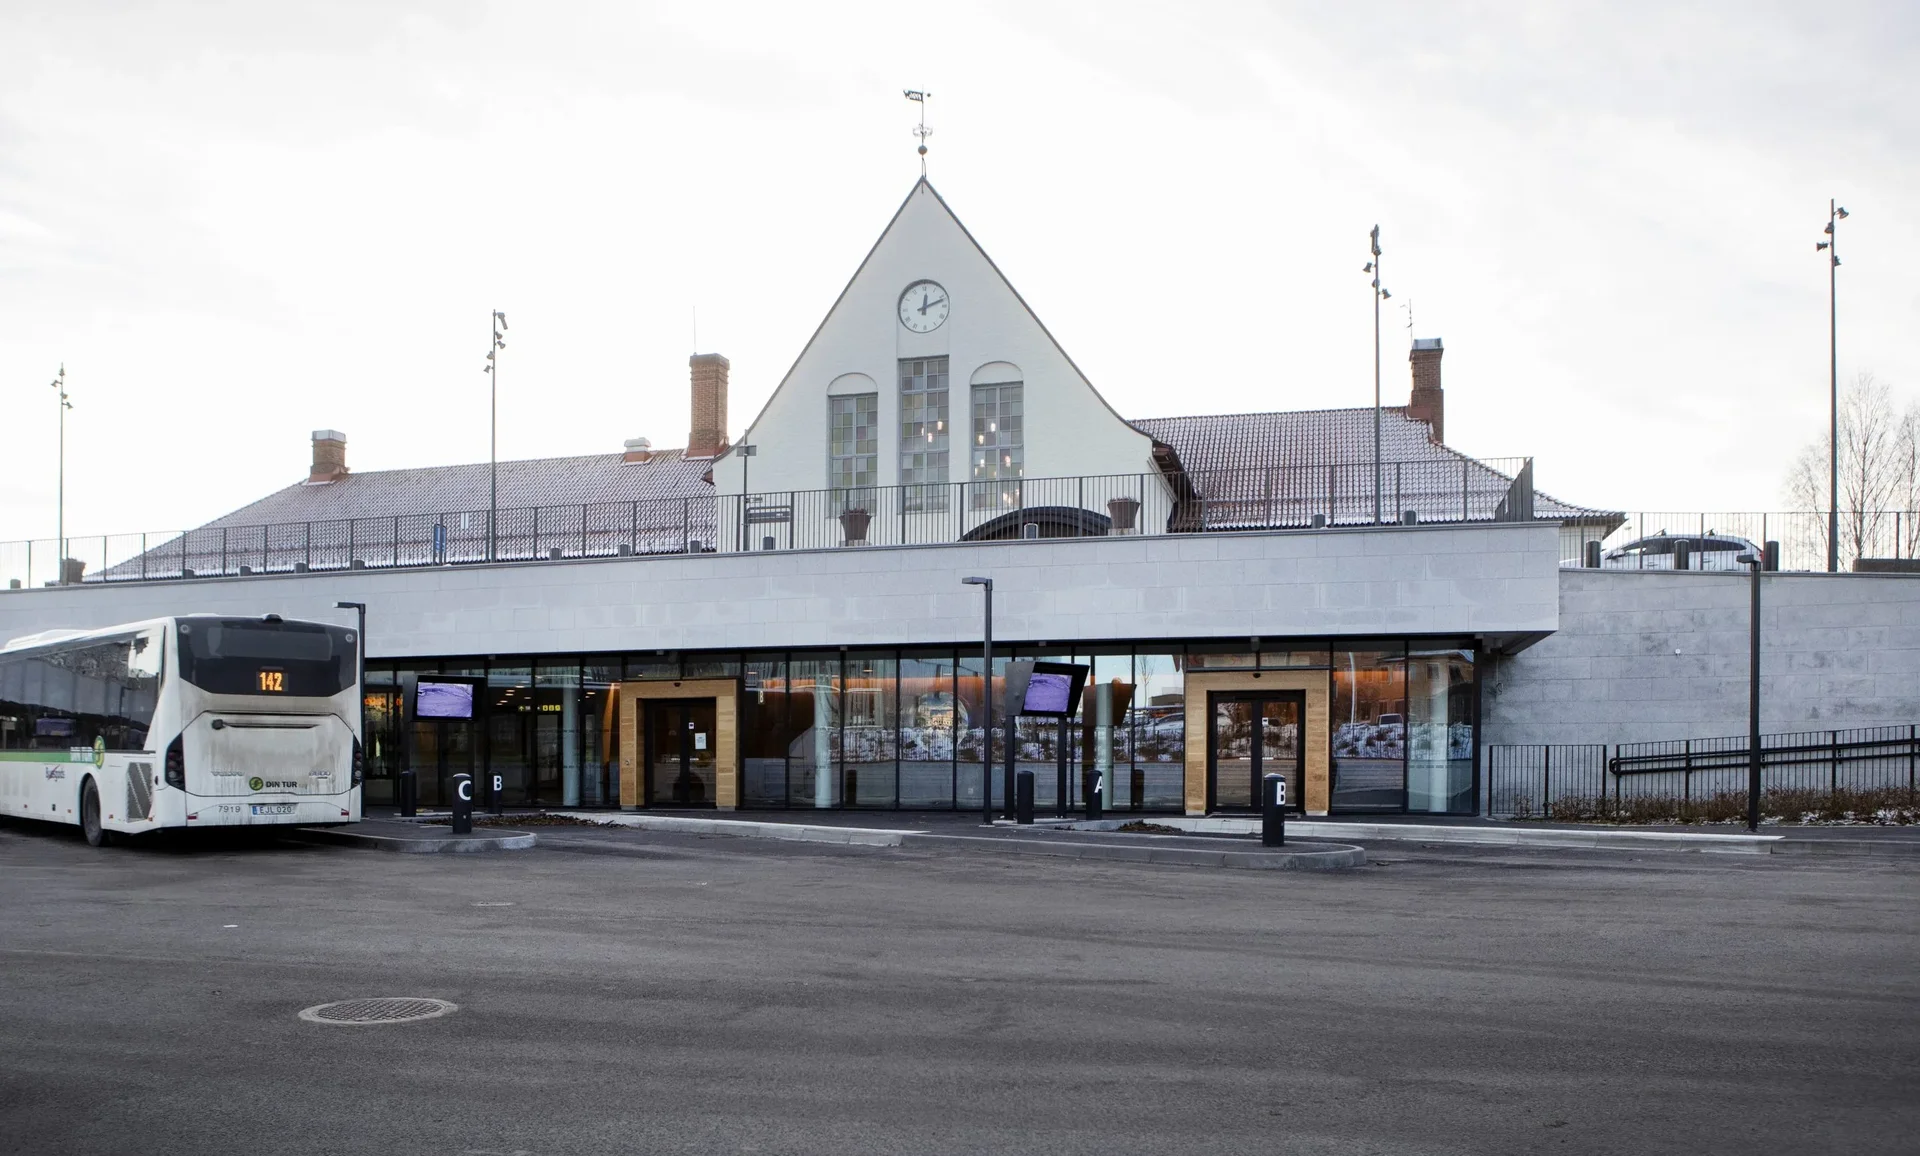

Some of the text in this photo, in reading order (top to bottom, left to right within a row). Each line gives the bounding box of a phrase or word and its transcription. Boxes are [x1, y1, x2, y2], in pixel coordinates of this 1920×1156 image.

[260, 672, 282, 691] 142
[458, 780, 472, 801] C
[493, 775, 503, 791] B
[1094, 775, 1103, 793] A
[1276, 781, 1286, 805] B
[219, 805, 241, 813] 7919
[259, 805, 274, 814] EJL
